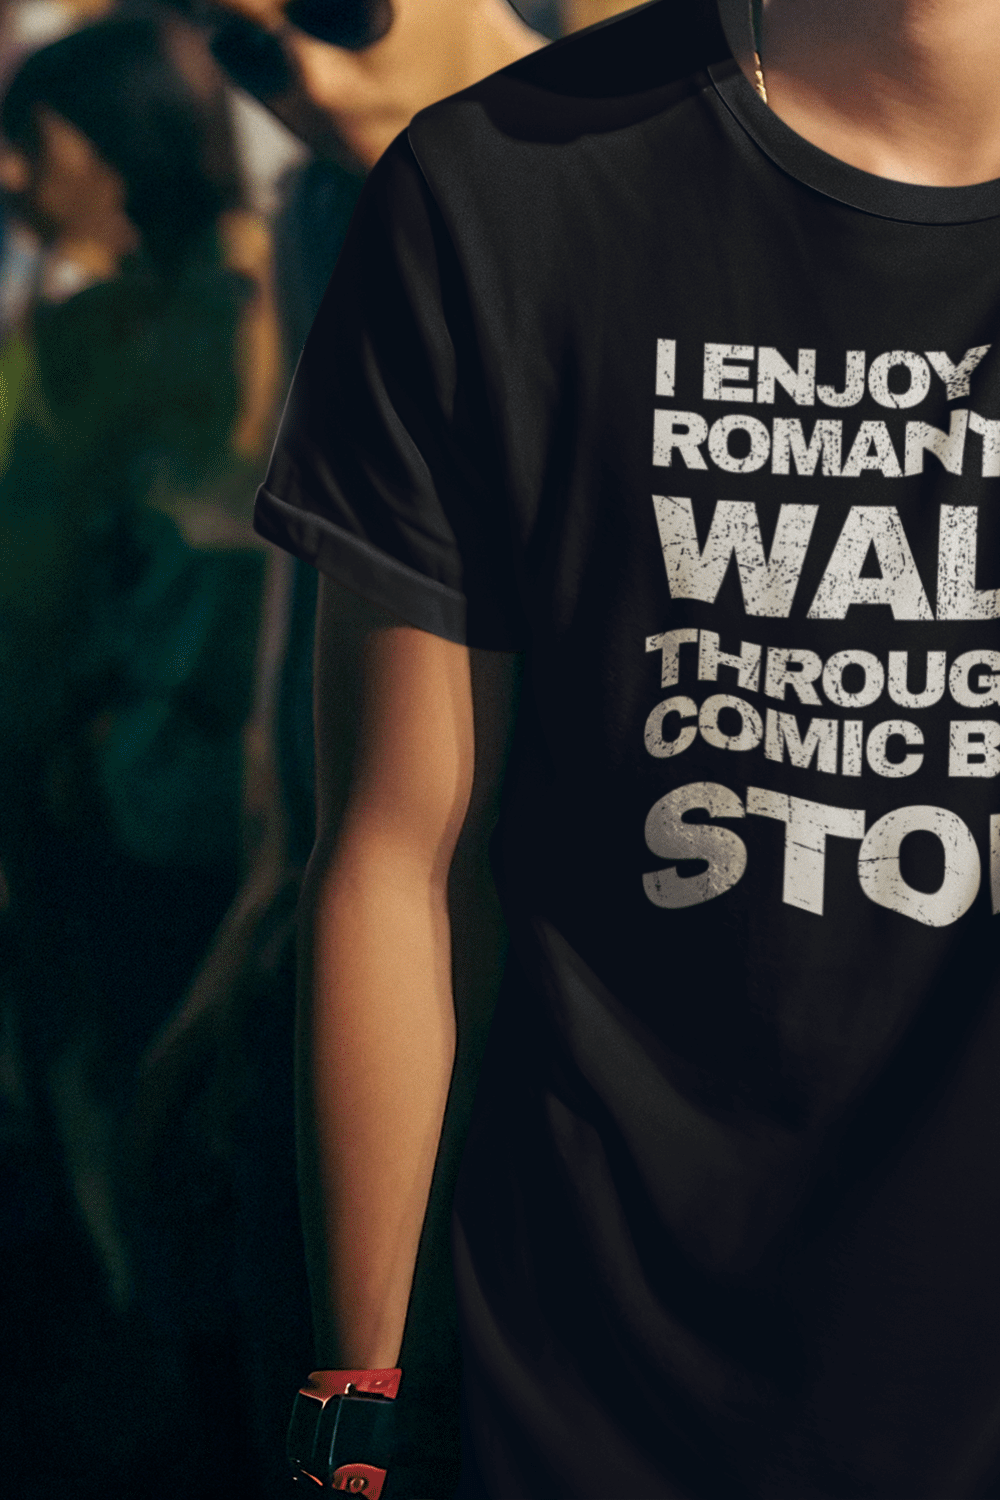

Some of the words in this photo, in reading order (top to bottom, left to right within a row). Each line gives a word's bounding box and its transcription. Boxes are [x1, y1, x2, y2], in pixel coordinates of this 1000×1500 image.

[656, 338, 676, 397] I
[703, 343, 991, 409] ENJOY
[644, 693, 925, 779] COMIC
